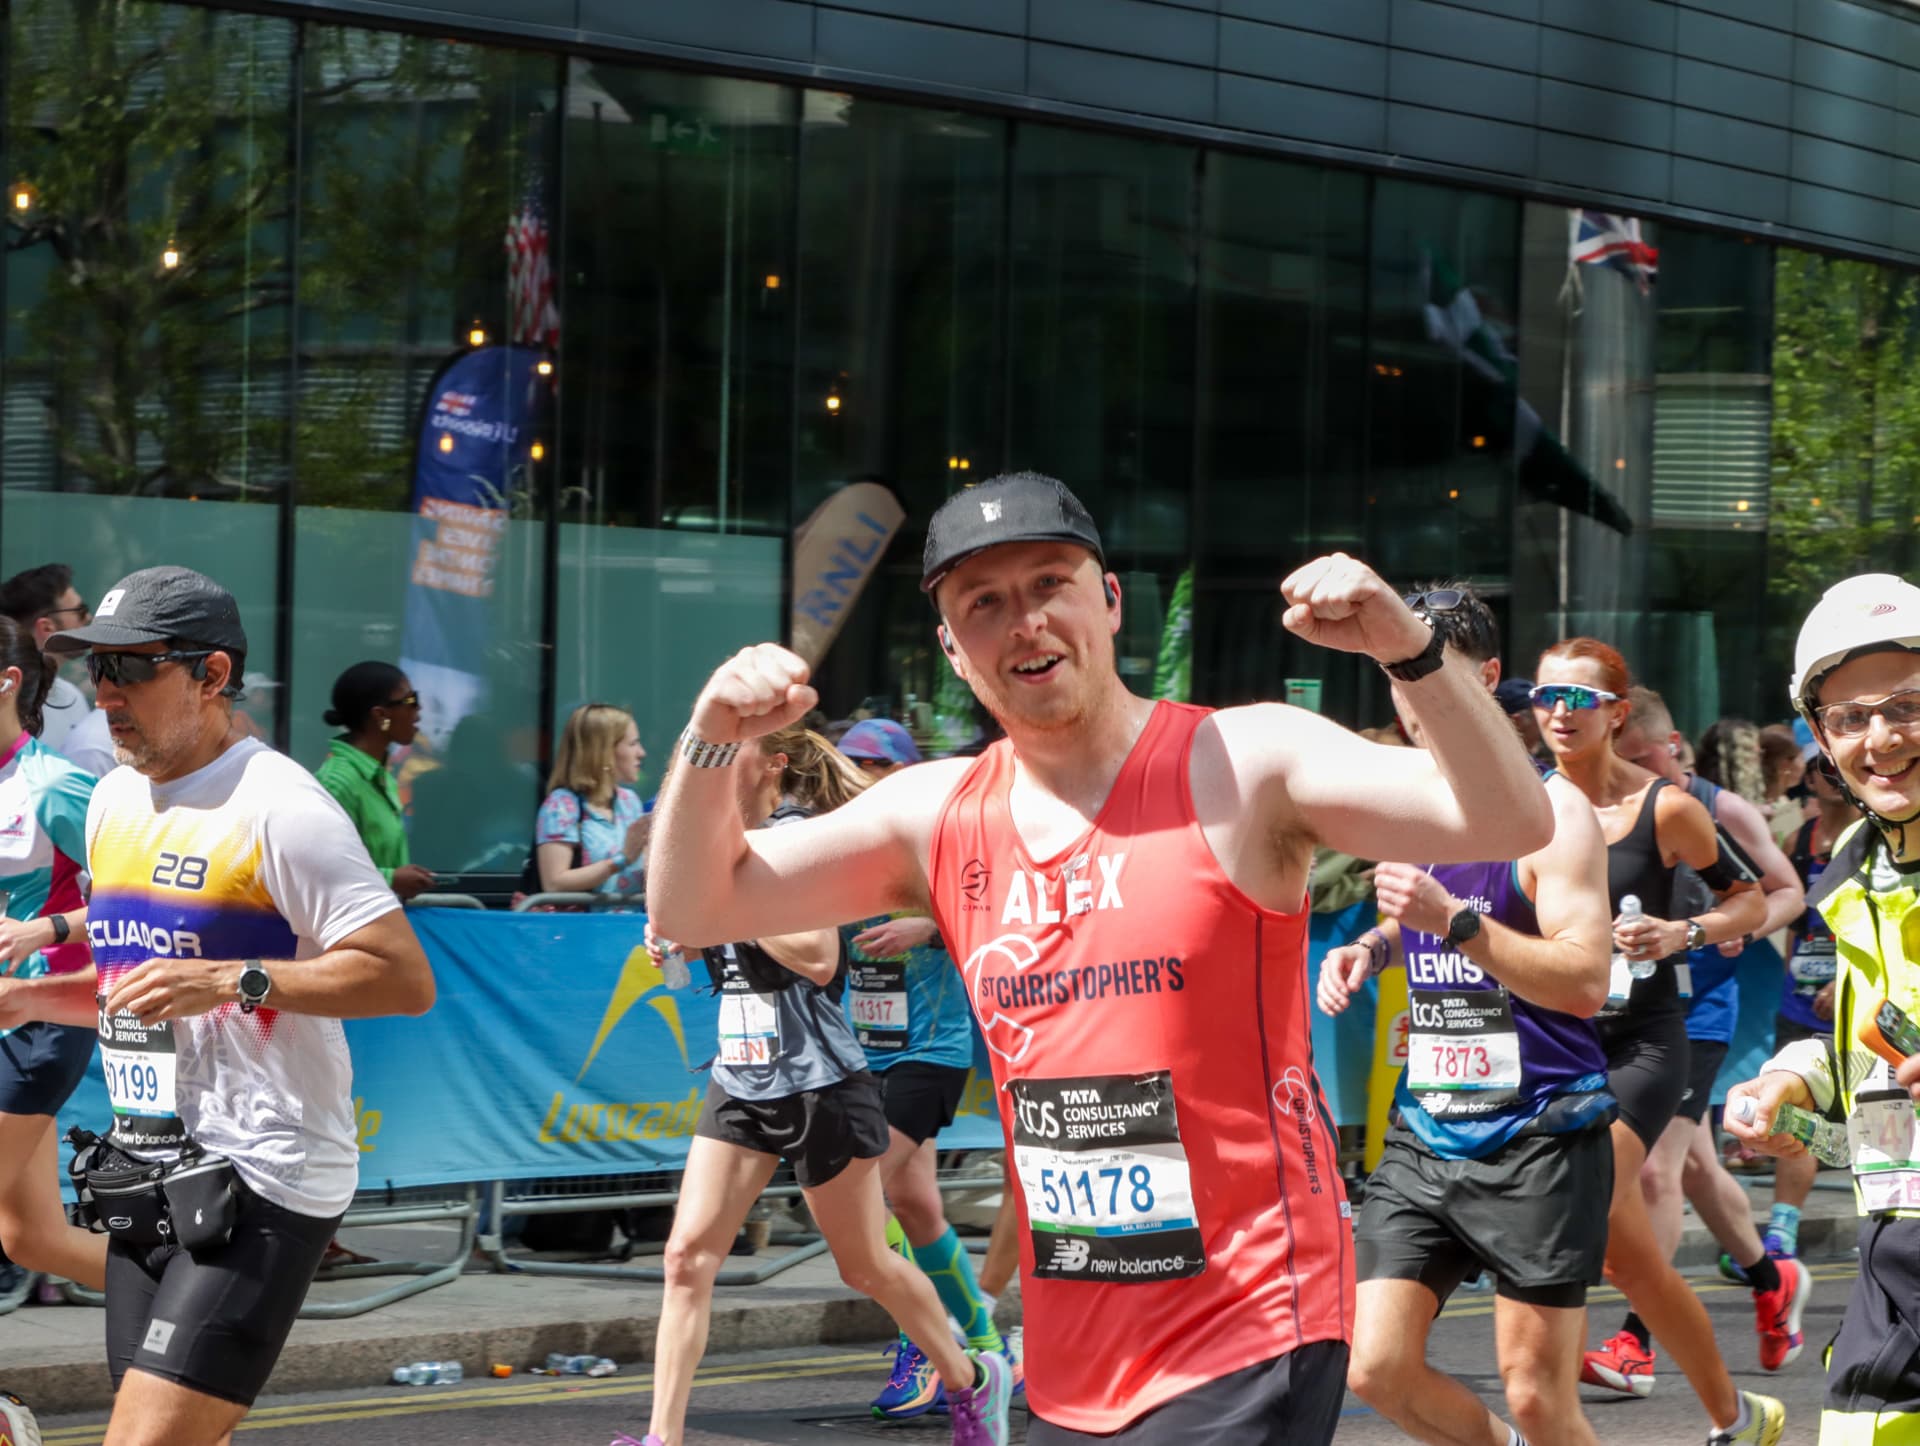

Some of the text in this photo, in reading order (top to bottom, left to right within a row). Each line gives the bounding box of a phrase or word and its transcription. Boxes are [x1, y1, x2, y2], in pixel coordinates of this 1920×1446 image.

[797, 512, 888, 627] RNLI
[152, 852, 208, 890] 28
[1001, 853, 1125, 925] ALEX
[1408, 952, 1484, 984] LEWIS
[981, 956, 1184, 1009] ST CHRISTOPHER'S
[1411, 997, 1444, 1028] tcs
[1441, 998, 1468, 1008] TATA
[1443, 1007, 1503, 1018] CONSULTANCY
[1446, 1018, 1485, 1029] SERVICES
[115, 1031, 148, 1044] SERVICES
[1432, 1046, 1491, 1078] 7873
[1060, 1089, 1101, 1104] TATA
[1063, 1101, 1160, 1122] CONSULTANCY
[1066, 1122, 1126, 1139] SERVICES
[1041, 1164, 1155, 1217] 51178
[1090, 1259, 1119, 1273] new
[1119, 1256, 1185, 1275] balance
